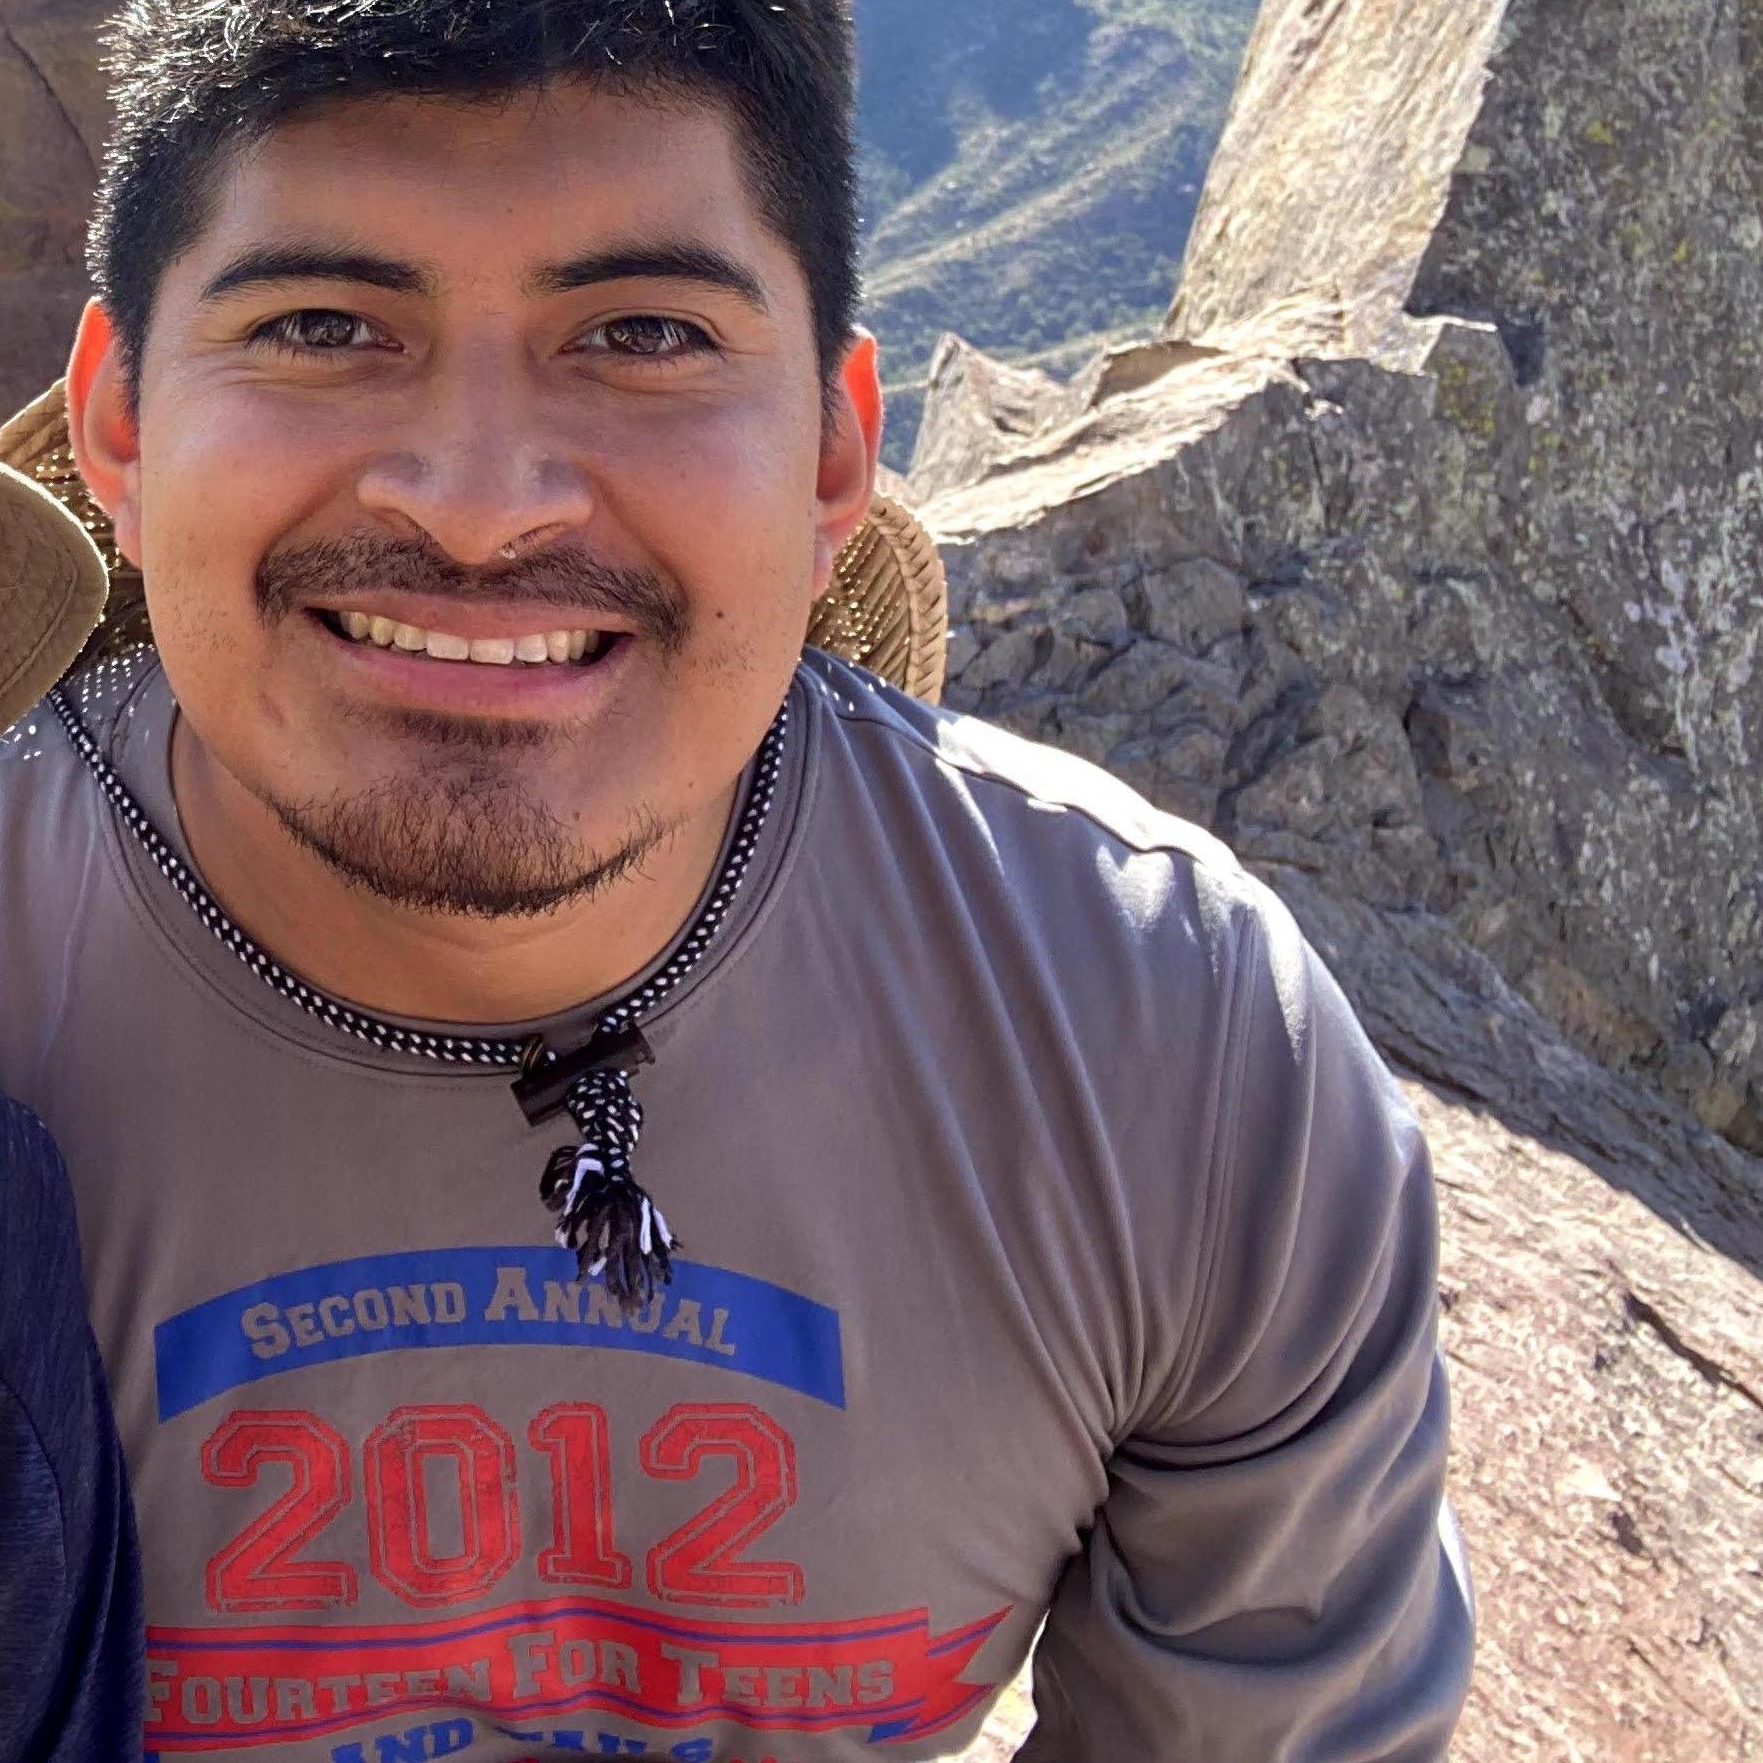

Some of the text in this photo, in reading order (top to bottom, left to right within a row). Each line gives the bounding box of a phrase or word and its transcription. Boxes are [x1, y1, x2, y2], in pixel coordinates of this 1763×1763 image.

[241, 1281, 467, 1360] SECOND
[200, 1401, 805, 1614] 2012
[506, 1630, 640, 1700] FOR
[660, 1641, 895, 1708] TEENS
